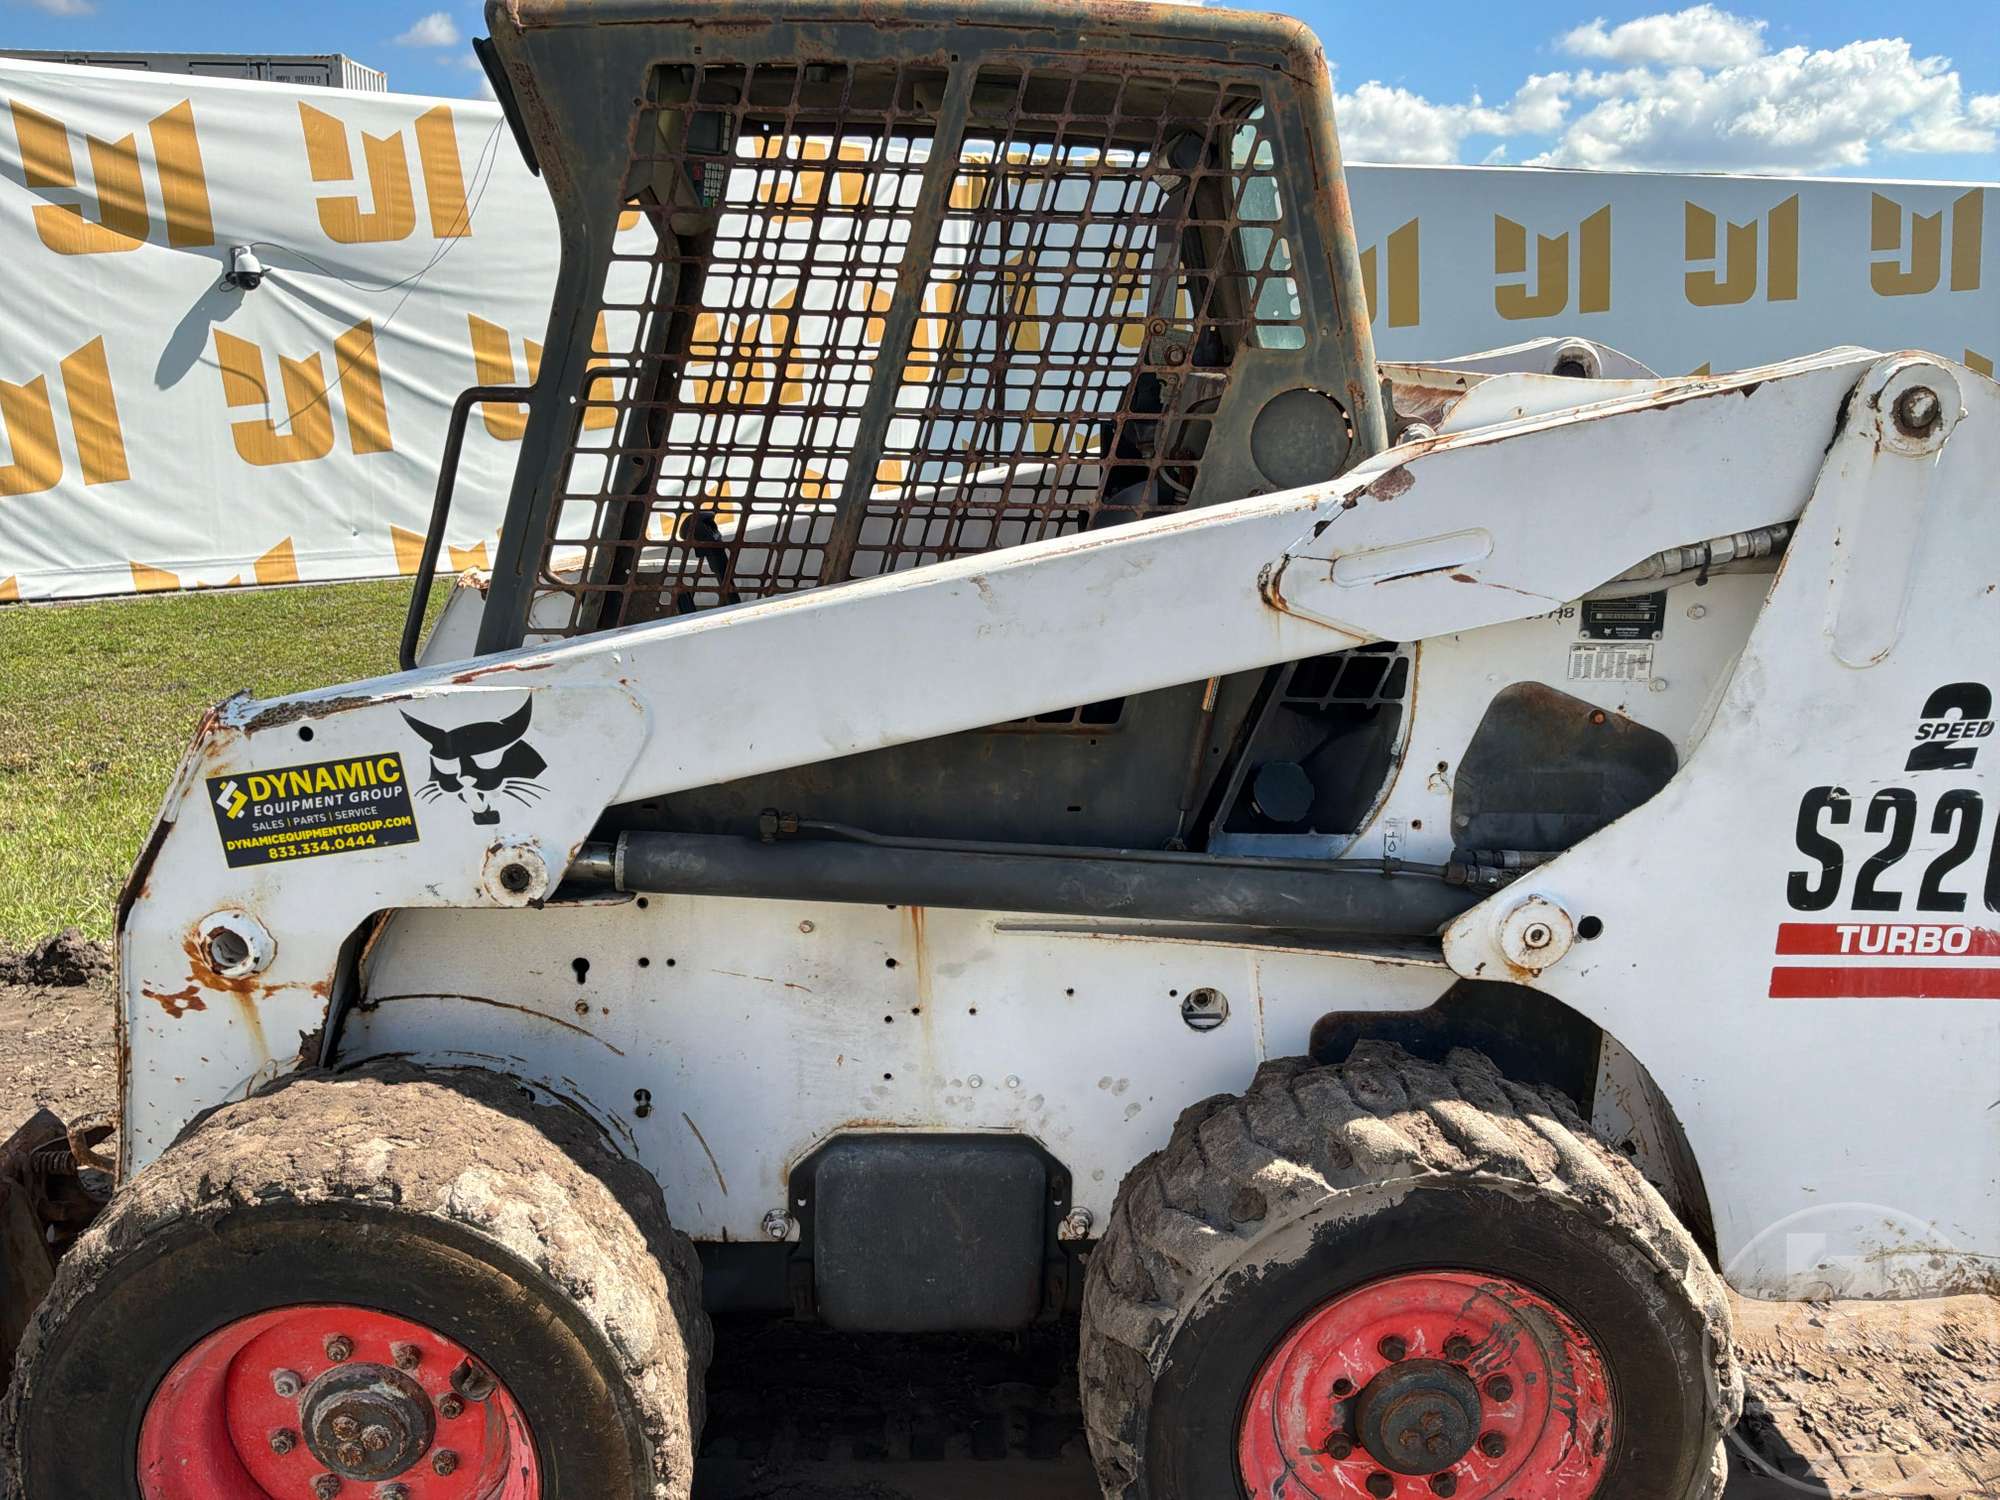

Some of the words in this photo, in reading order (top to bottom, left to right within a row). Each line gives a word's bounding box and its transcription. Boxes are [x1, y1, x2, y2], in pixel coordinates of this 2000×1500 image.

[1914, 720, 1996, 741] SPEED
[247, 757, 401, 801] DYNAMIC
[253, 794, 345, 816] EQUIPMENT
[349, 785, 403, 803] GROUP
[226, 816, 412, 850] DYNAMICEQUIPMENTGROUP.COM
[252, 819, 285, 832] SALES
[293, 813, 327, 826] PARTS
[335, 806, 378, 820] SERVICE
[268, 834, 376, 859] 833.334.0444
[1786, 785, 2000, 913] S22
[1836, 925, 1972, 954] TURBO
